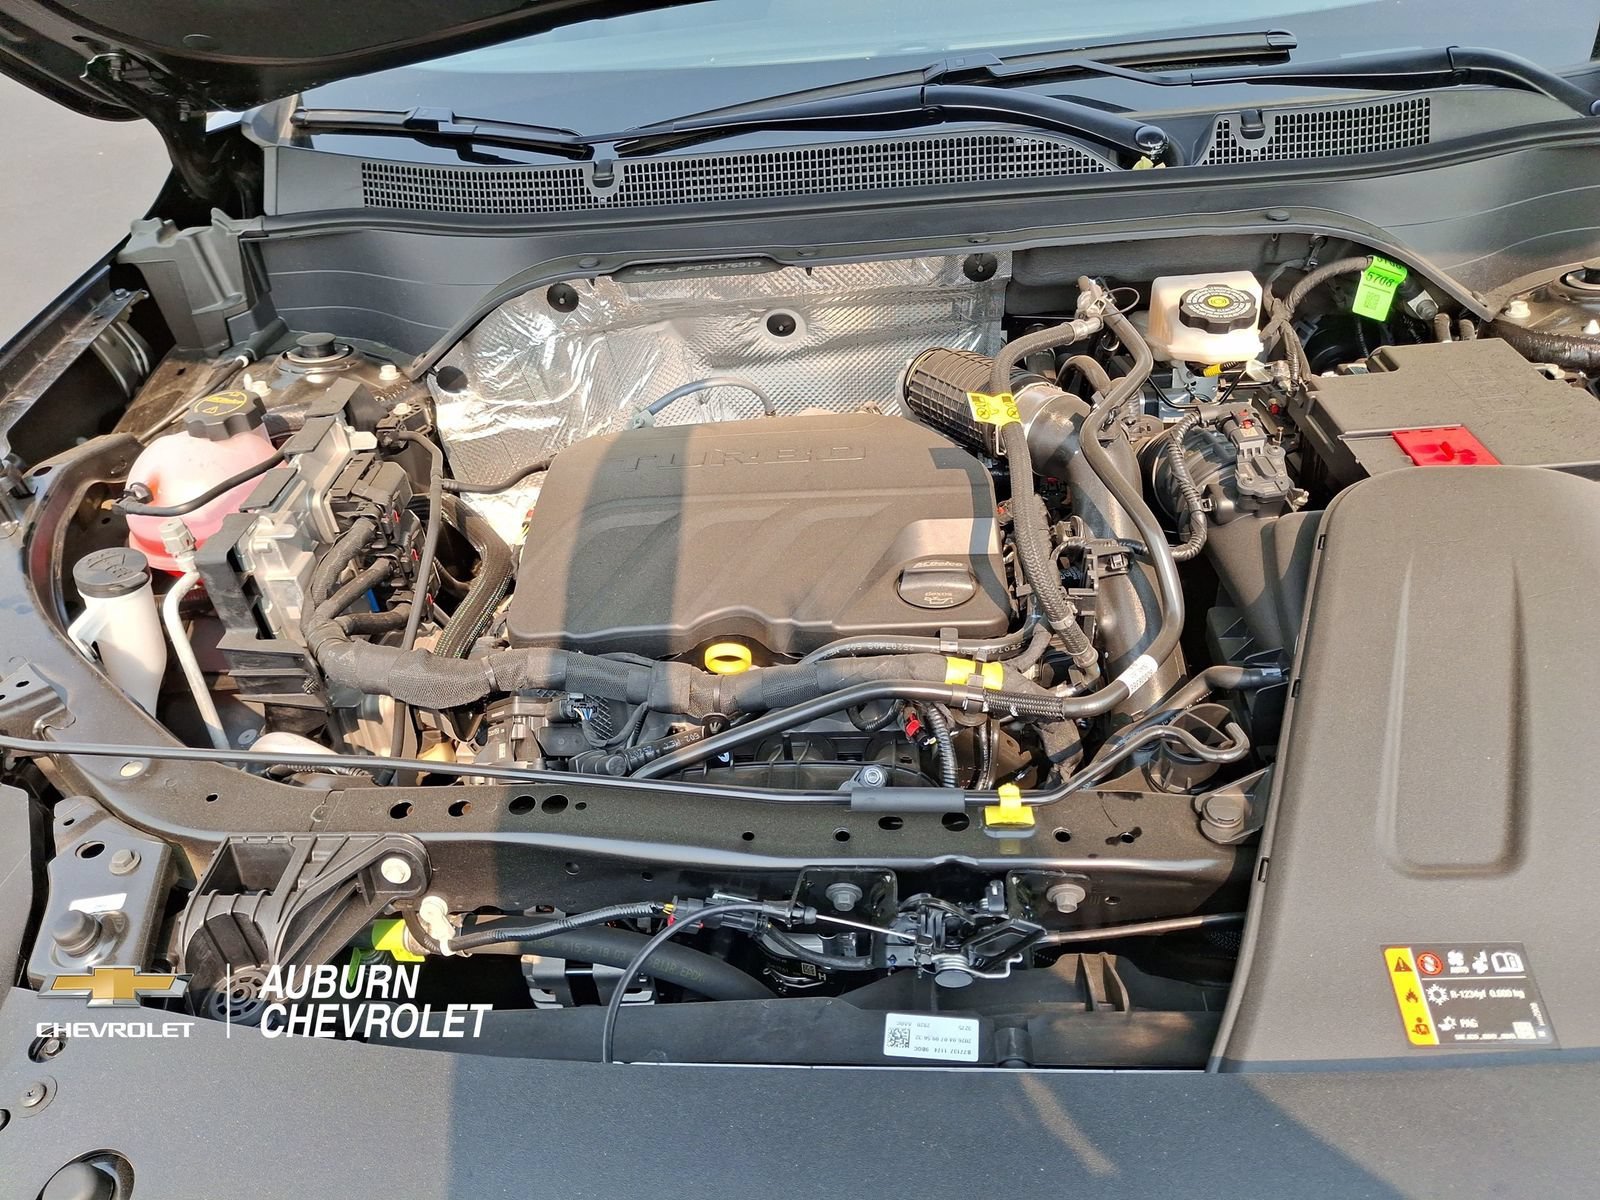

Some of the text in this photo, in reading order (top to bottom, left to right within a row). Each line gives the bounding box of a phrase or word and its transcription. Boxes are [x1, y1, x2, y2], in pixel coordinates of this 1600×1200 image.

[1366, 271, 1395, 287] 5708
[606, 446, 866, 473] TURBO
[912, 561, 963, 569] ACDelco
